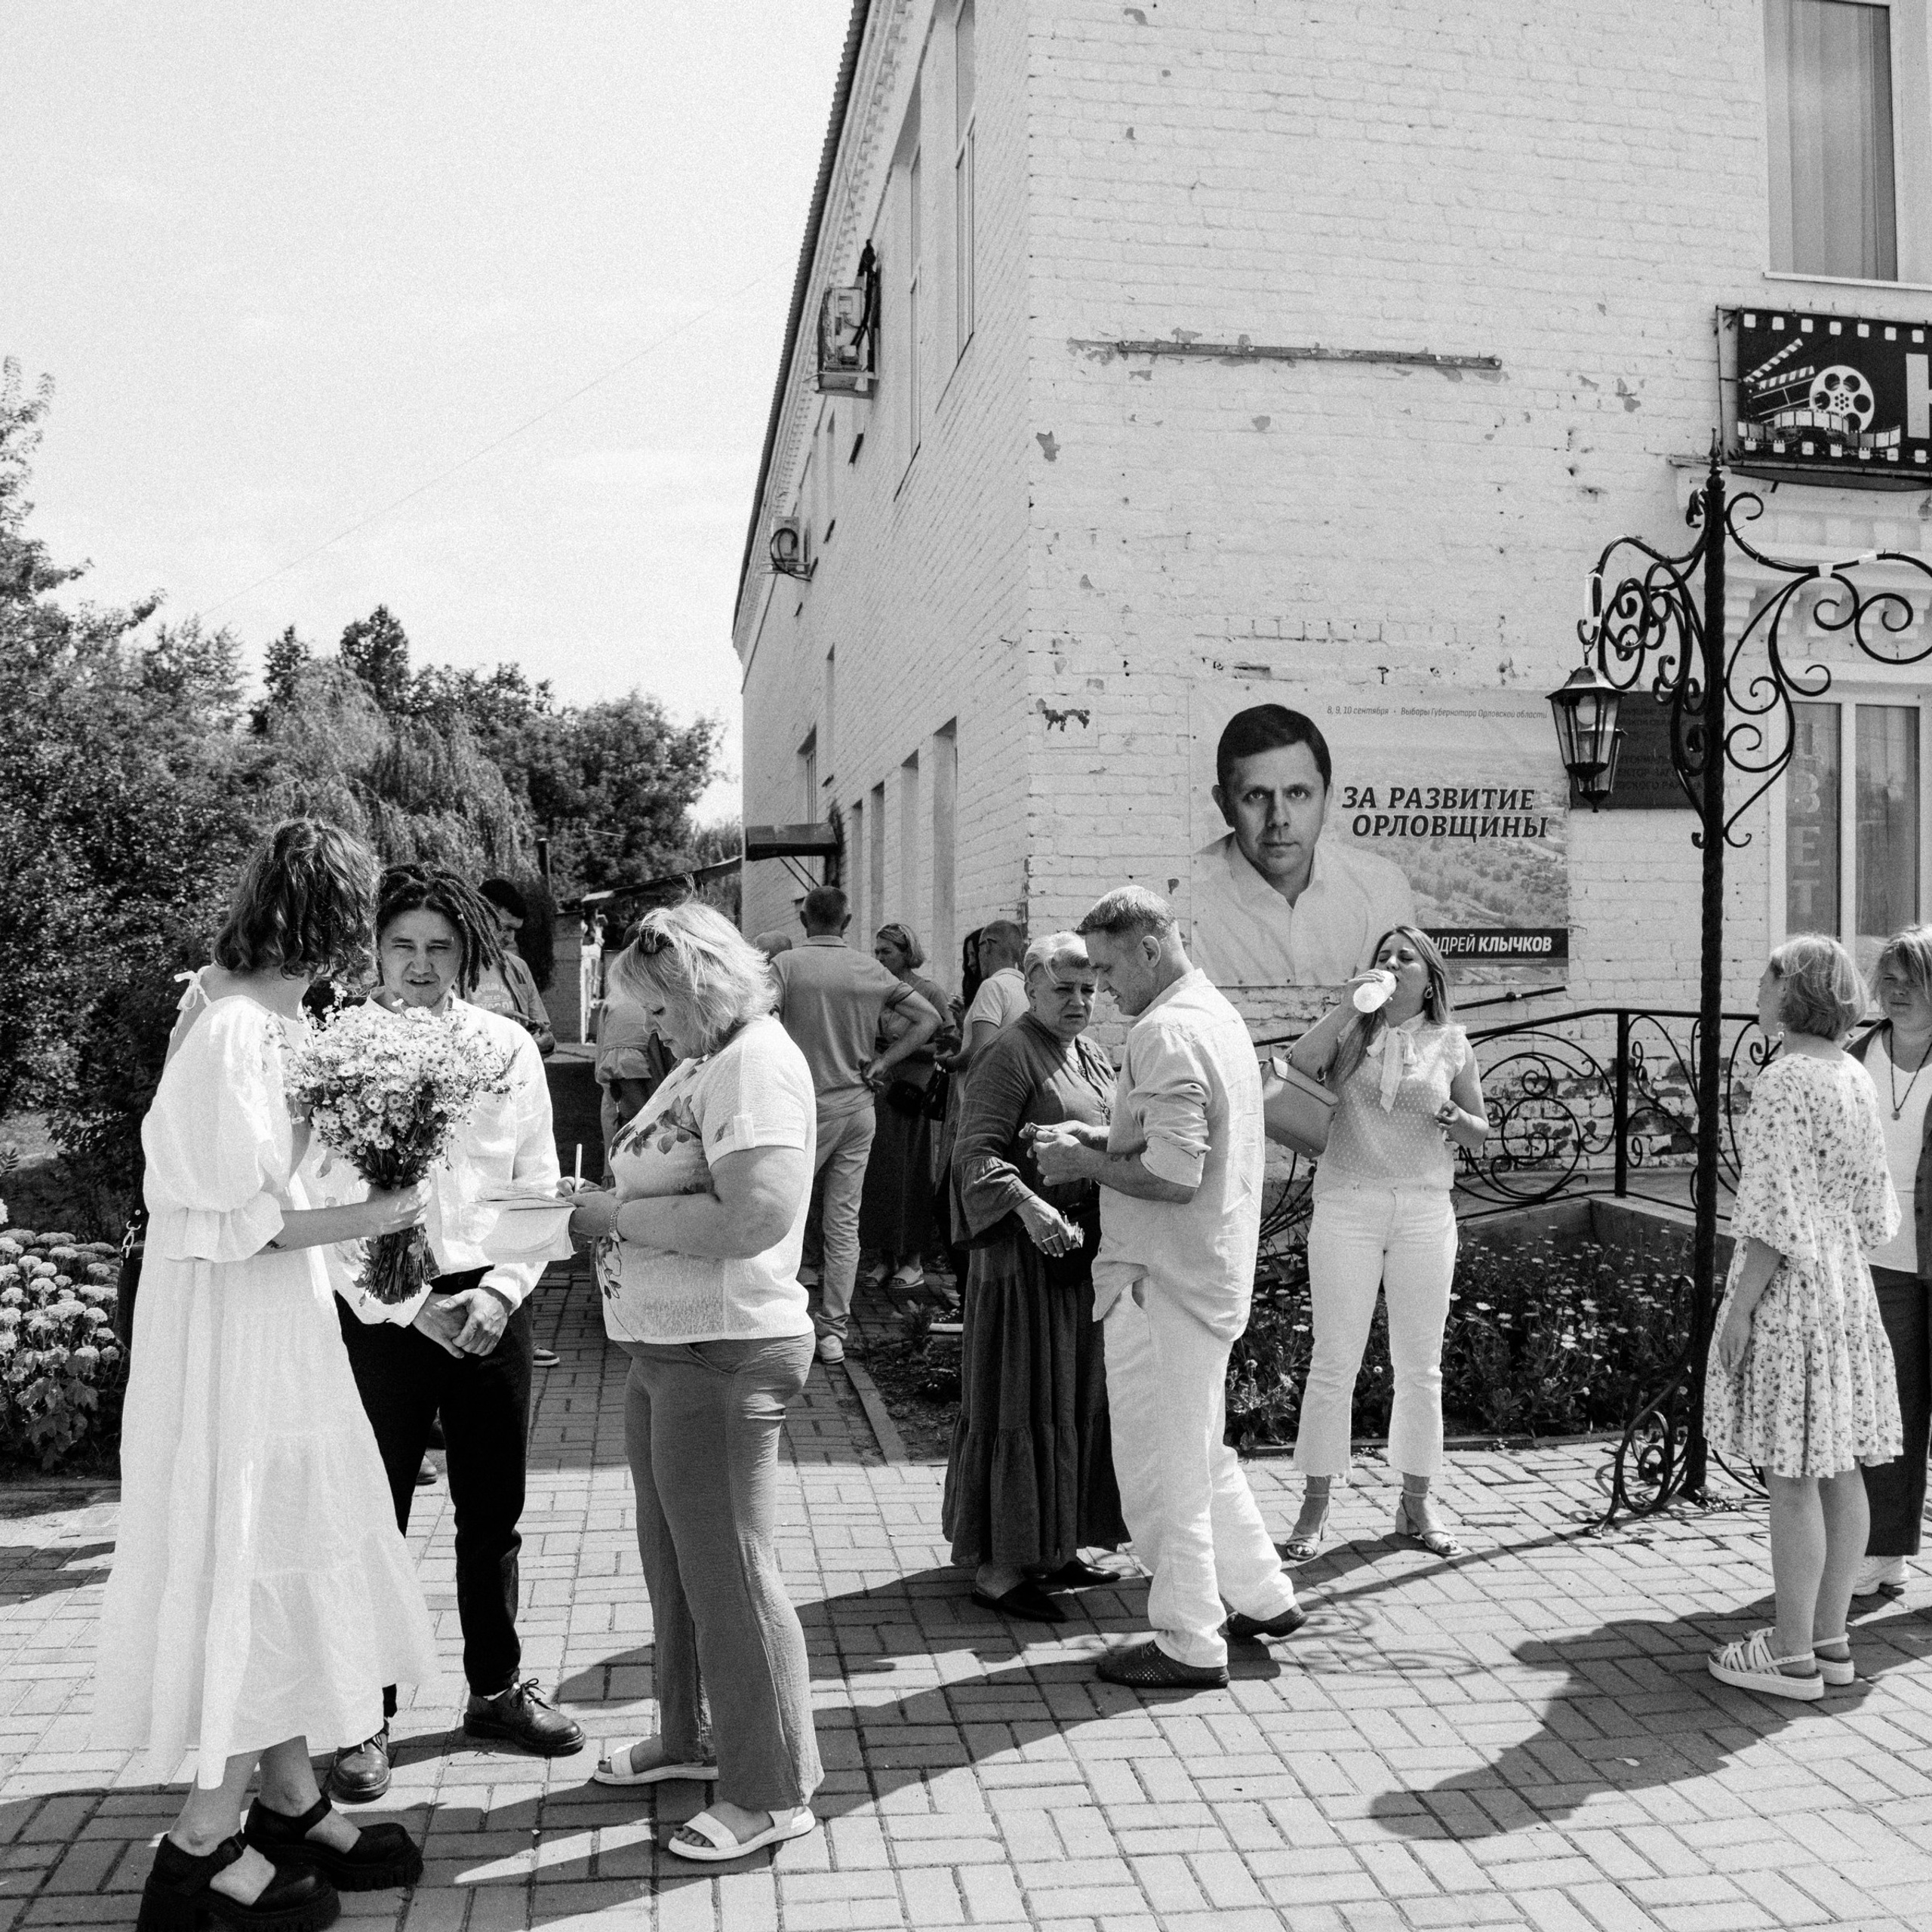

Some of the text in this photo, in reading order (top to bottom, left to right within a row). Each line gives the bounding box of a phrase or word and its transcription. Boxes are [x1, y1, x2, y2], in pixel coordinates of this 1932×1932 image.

[1327, 706, 1334, 715] 8,
[1335, 706, 1342, 715] 9,
[1343, 706, 1352, 715] 10
[1353, 706, 1389, 716] сентября
[1401, 707, 1430, 716] Выборы
[1431, 707, 1476, 718] Губернатора
[1516, 709, 1548, 718] области
[1342, 786, 1535, 810] ЗА РАЗВИТИЕ
[1352, 815, 1549, 843] ОРЛОВЩИНЫ
[1432, 934, 1552, 955] НДРЕЙ КЛЫЧКОВ
